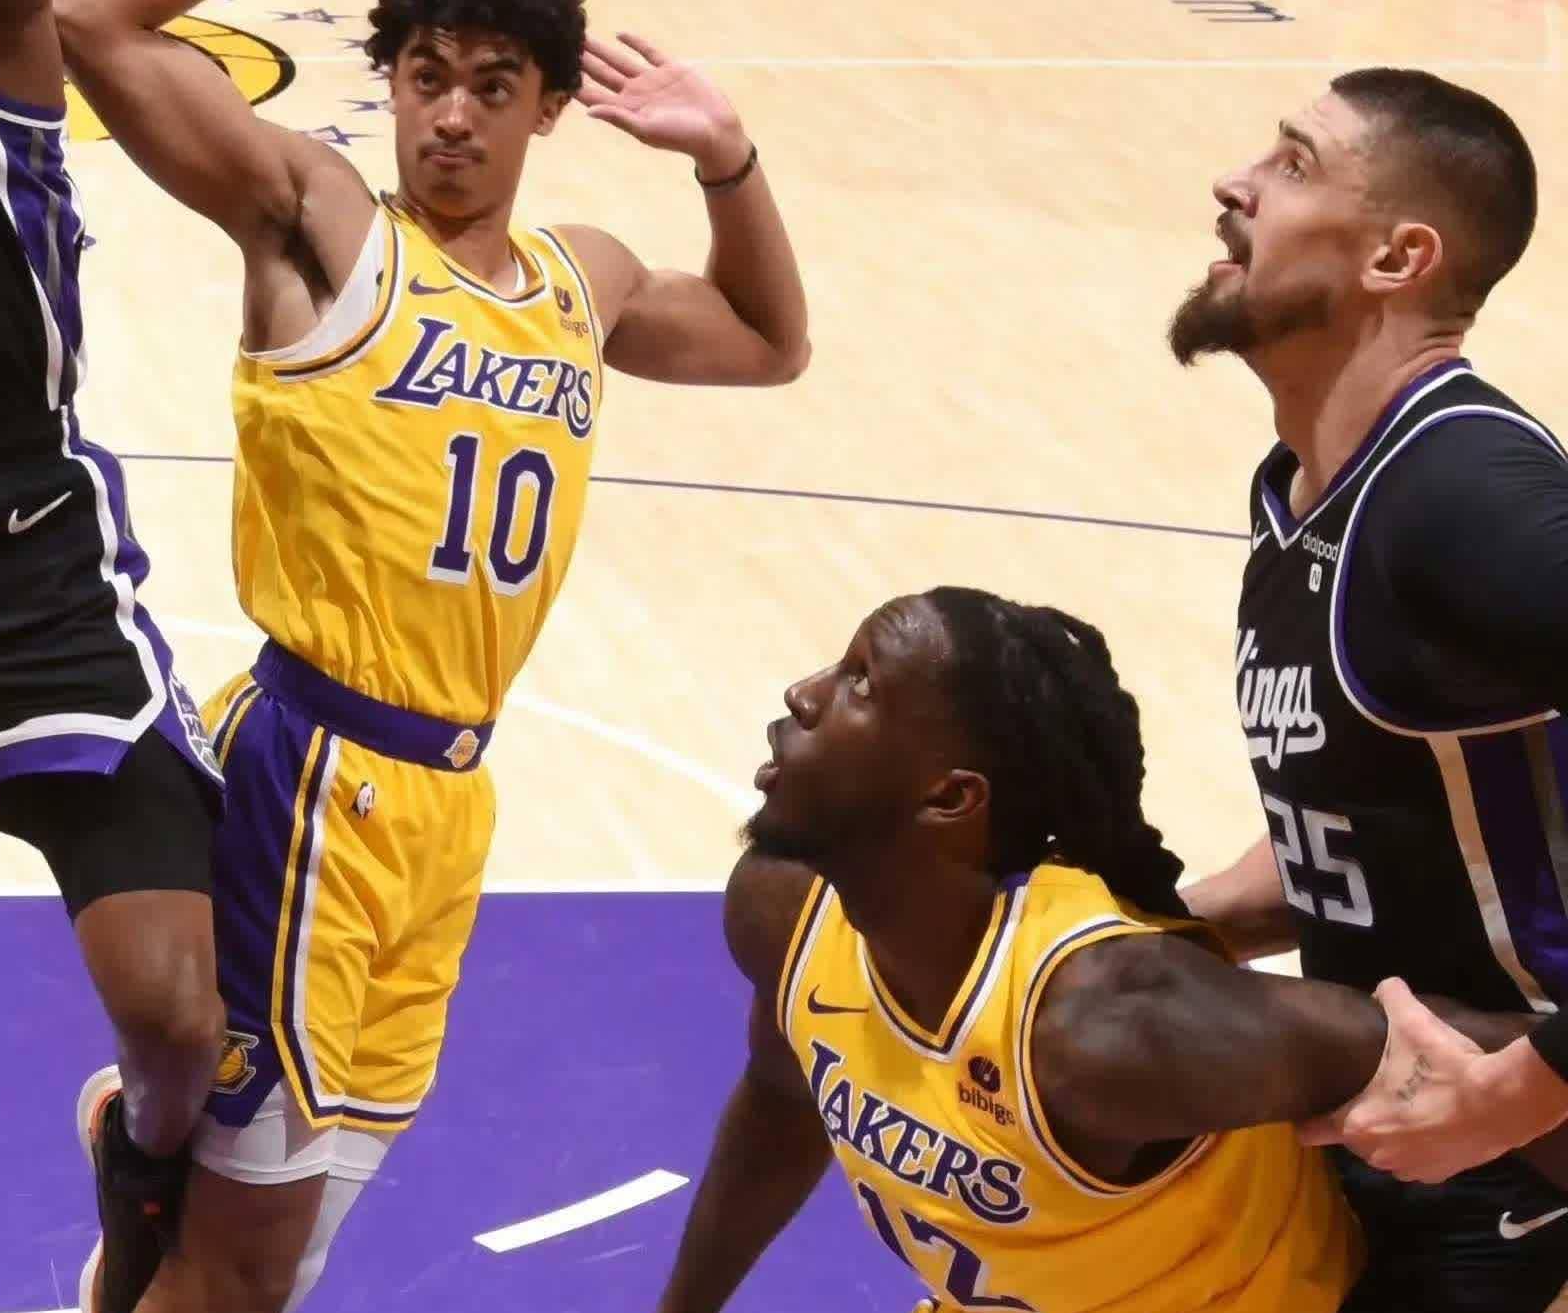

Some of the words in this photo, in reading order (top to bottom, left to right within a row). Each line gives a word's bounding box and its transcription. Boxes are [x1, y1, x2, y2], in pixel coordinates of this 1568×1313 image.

[372, 315, 595, 439] LAKERS
[428, 431, 557, 598] 10
[1264, 792, 1374, 928] 25
[809, 1039, 1032, 1228] LAKERS
